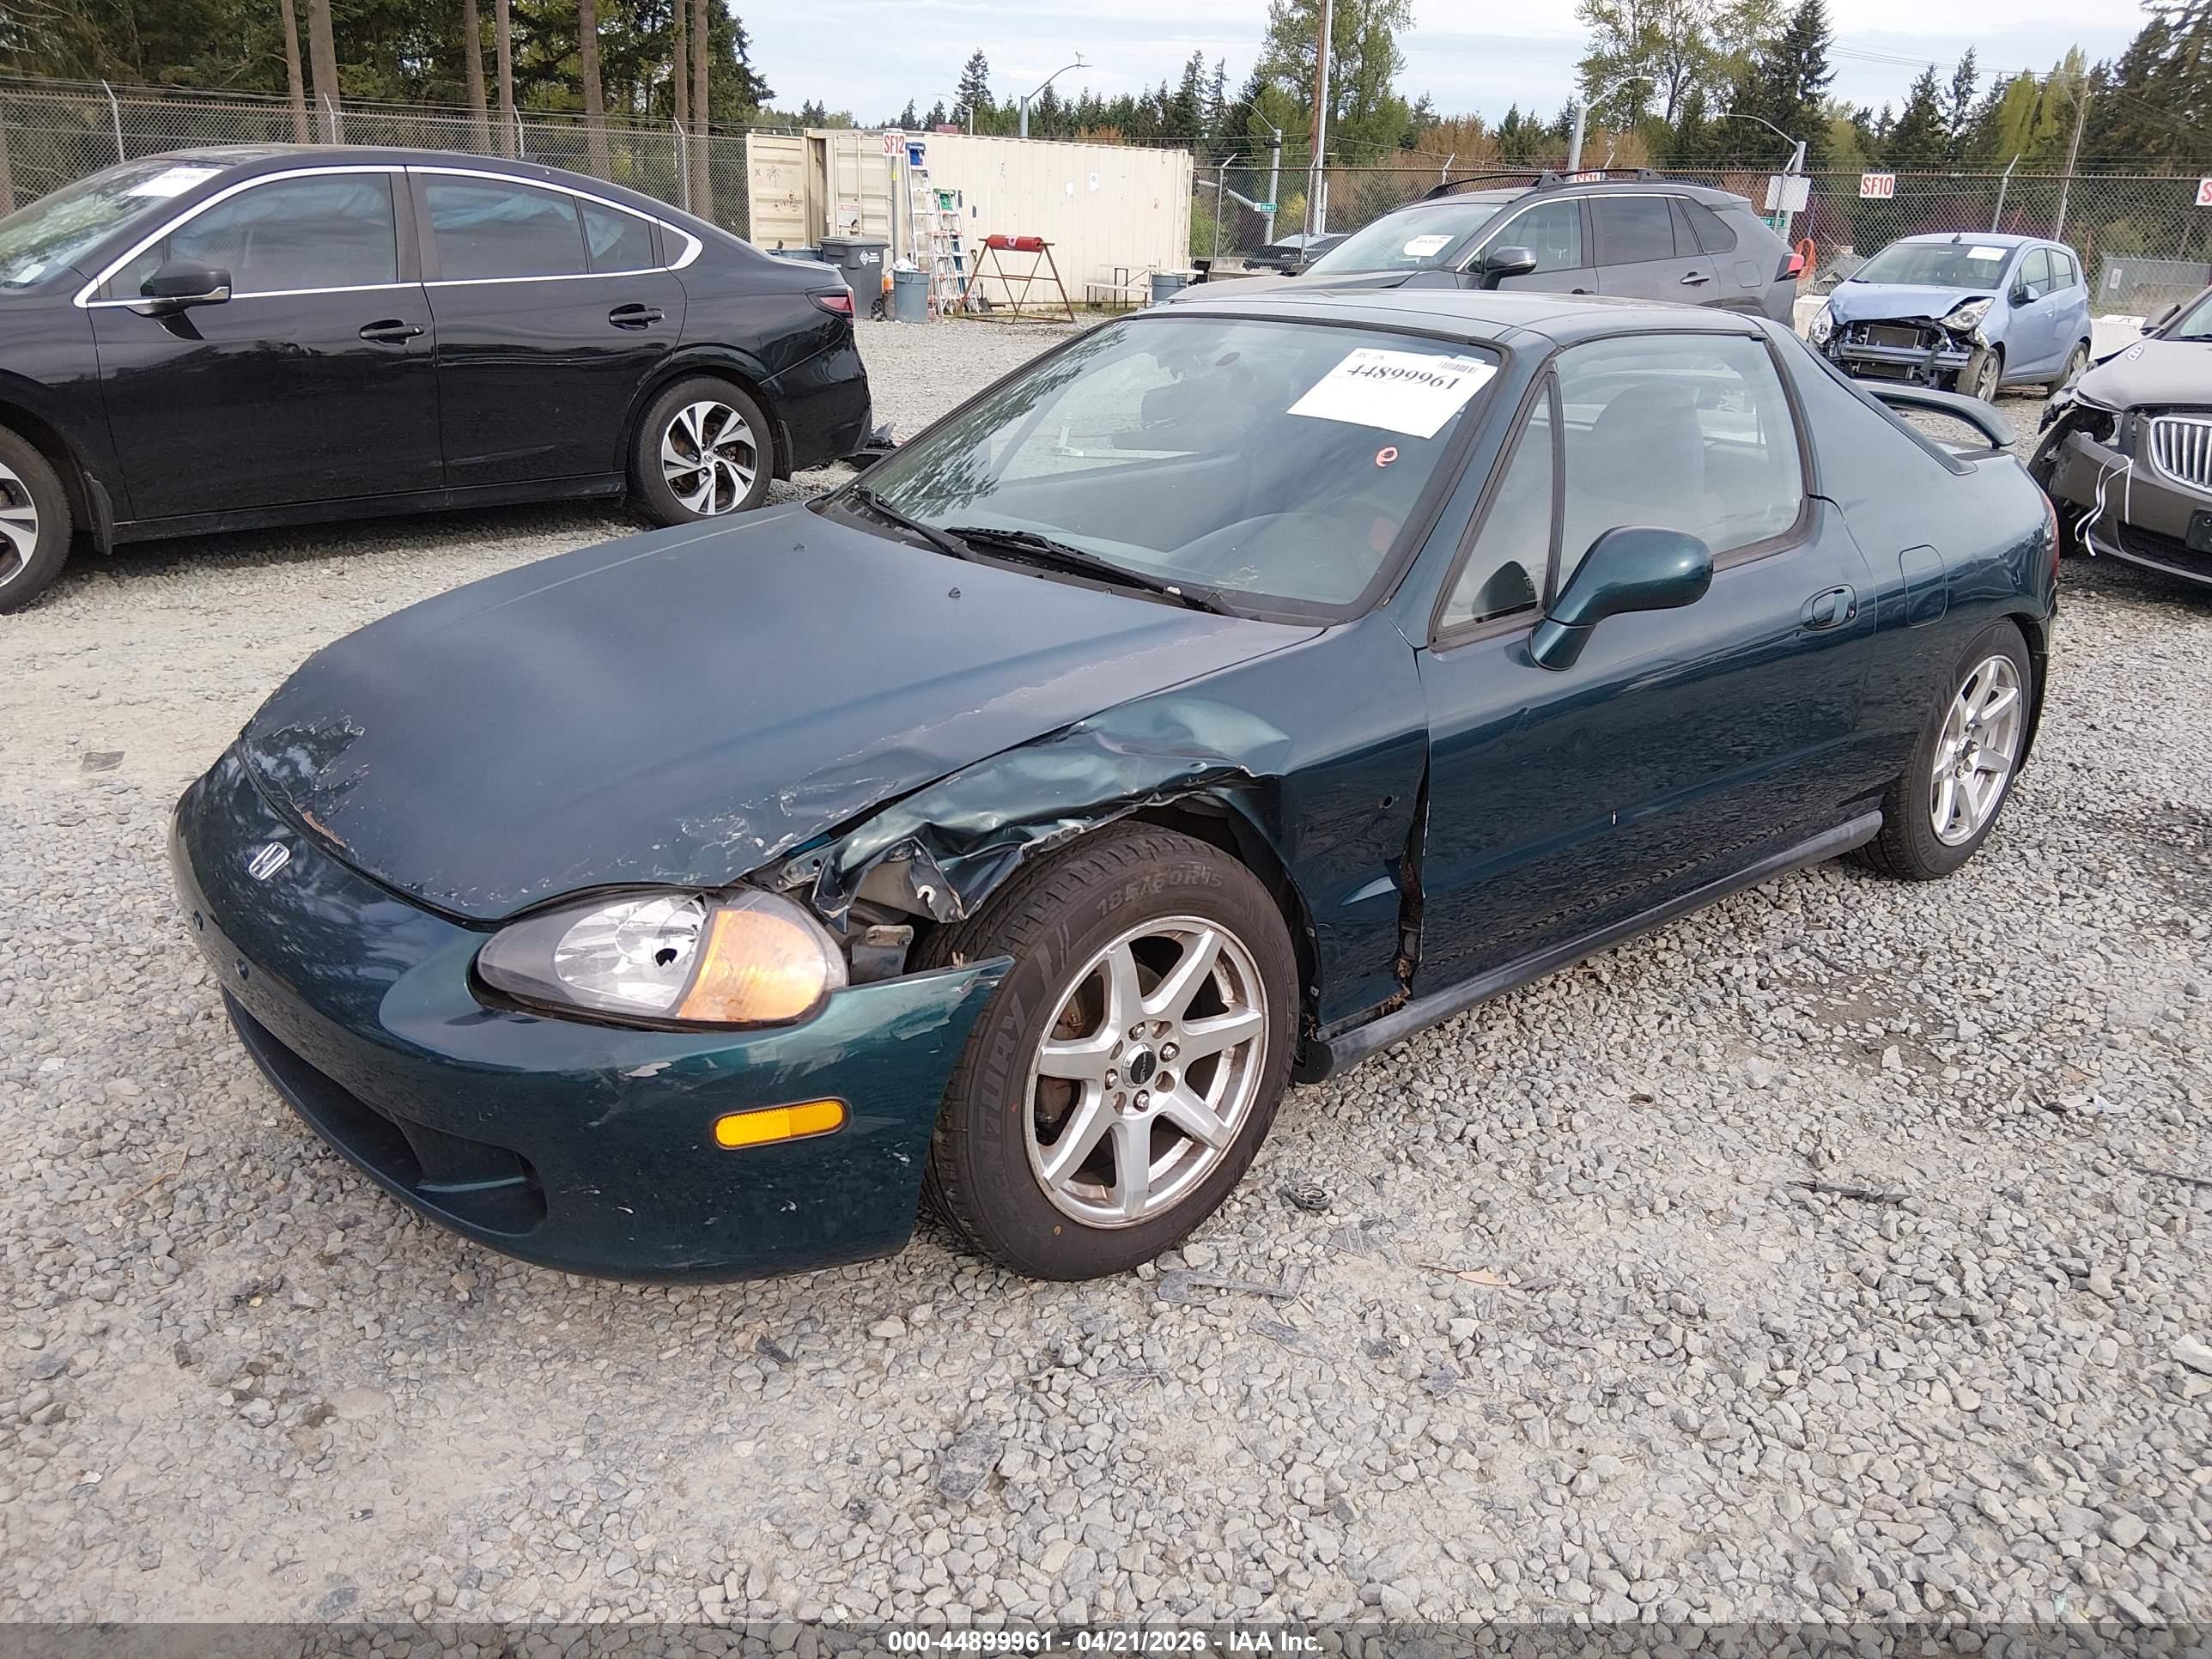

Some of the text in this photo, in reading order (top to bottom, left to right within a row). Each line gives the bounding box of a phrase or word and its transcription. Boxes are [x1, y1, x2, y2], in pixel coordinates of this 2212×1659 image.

[884, 134, 905, 154] SF12
[1862, 176, 1893, 196] SF10
[1347, 364, 1460, 390] 44899961
